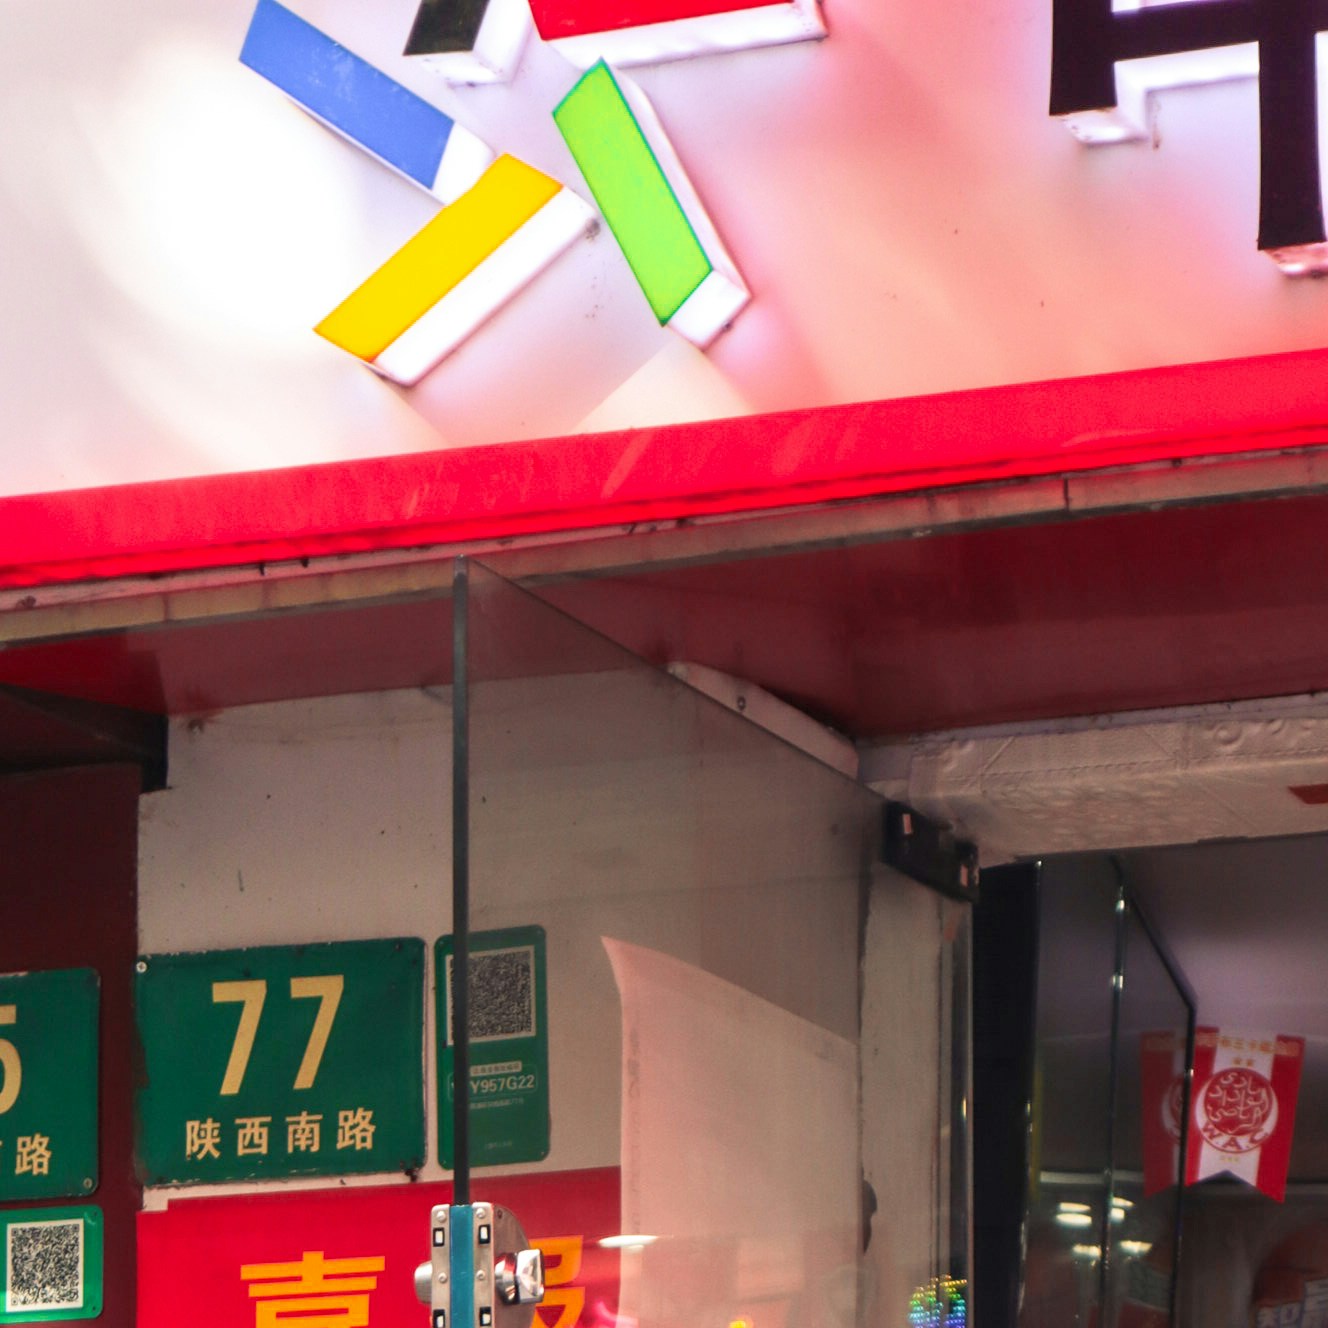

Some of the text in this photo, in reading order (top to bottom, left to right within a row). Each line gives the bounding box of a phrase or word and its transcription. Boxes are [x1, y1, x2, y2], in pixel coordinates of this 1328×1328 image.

[211, 975, 345, 1098] 77
[184, 1106, 376, 1161] 陕西南路
